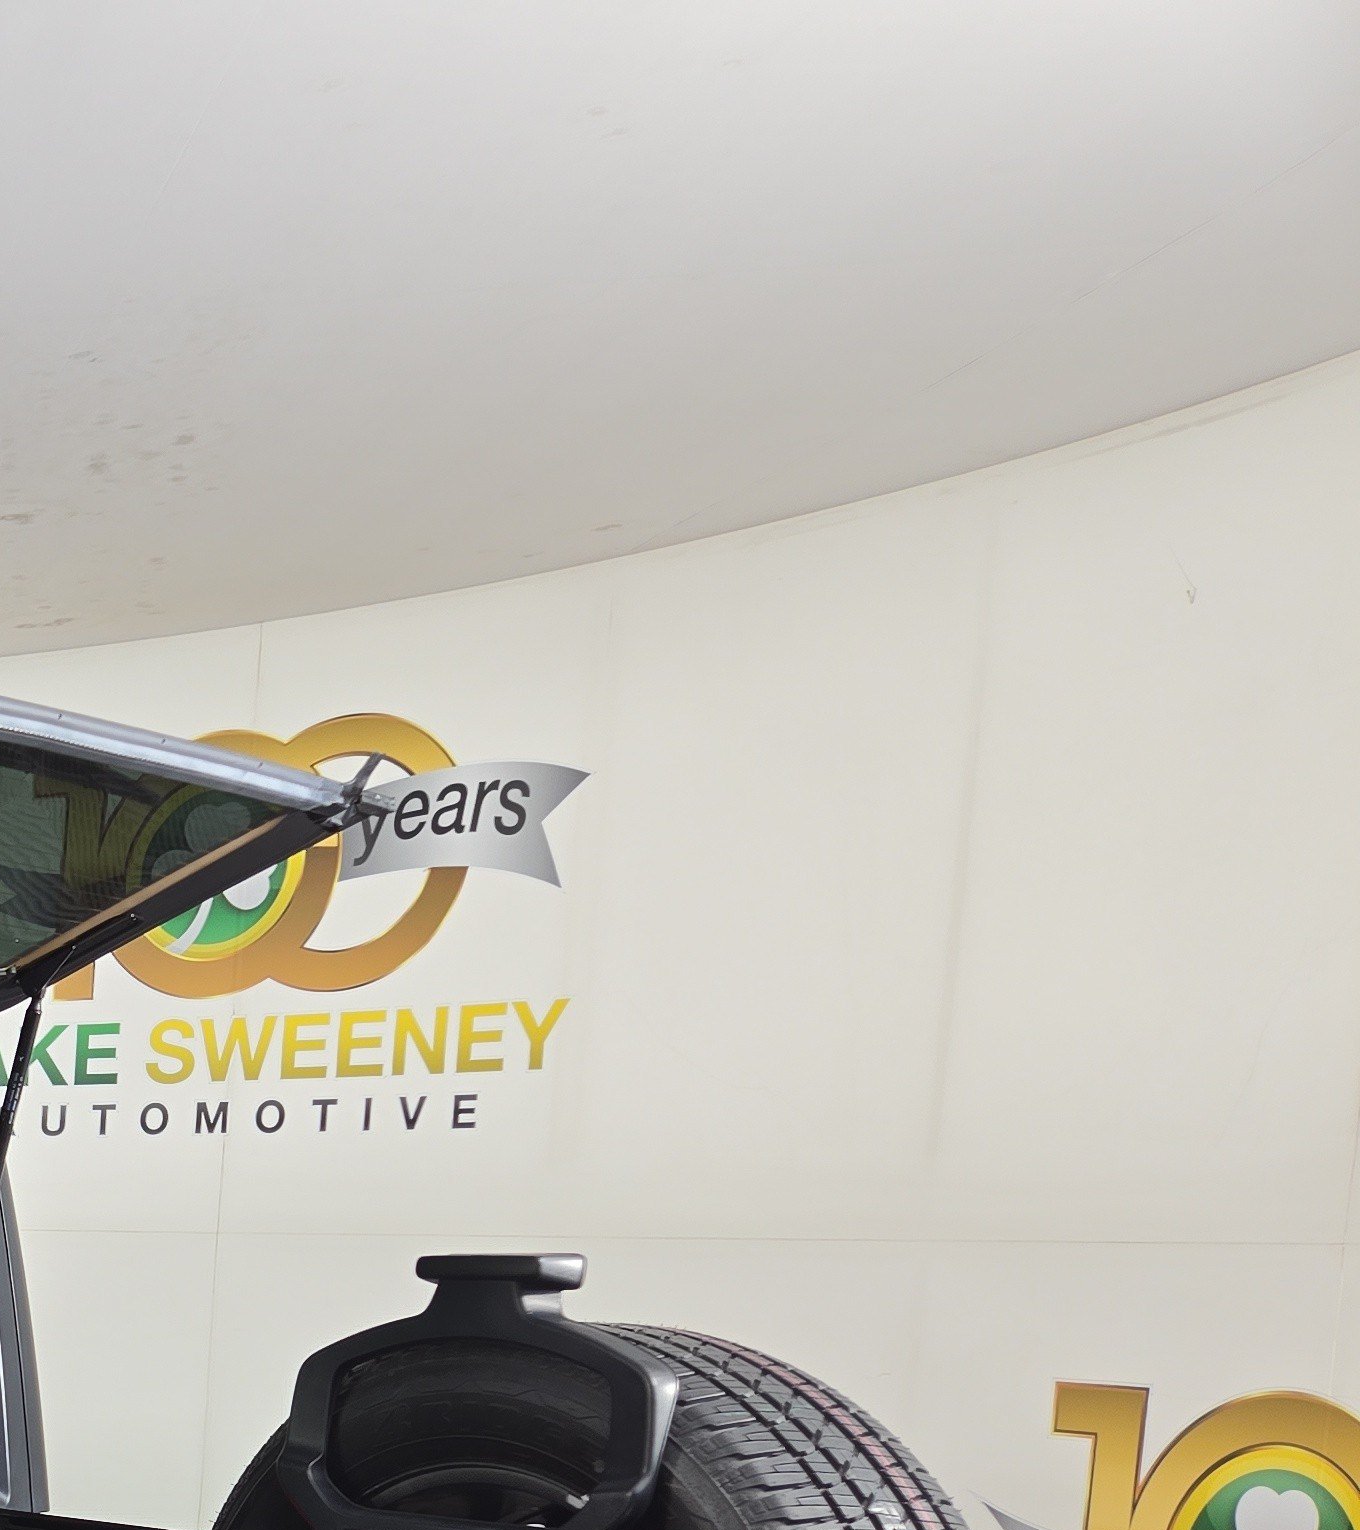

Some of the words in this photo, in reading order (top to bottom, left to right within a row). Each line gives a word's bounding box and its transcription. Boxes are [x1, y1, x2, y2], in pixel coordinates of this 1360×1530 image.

[353, 779, 531, 867] years
[144, 998, 572, 1086] SWEENEY
[12, 1094, 480, 1138] UTOMOTIVE
